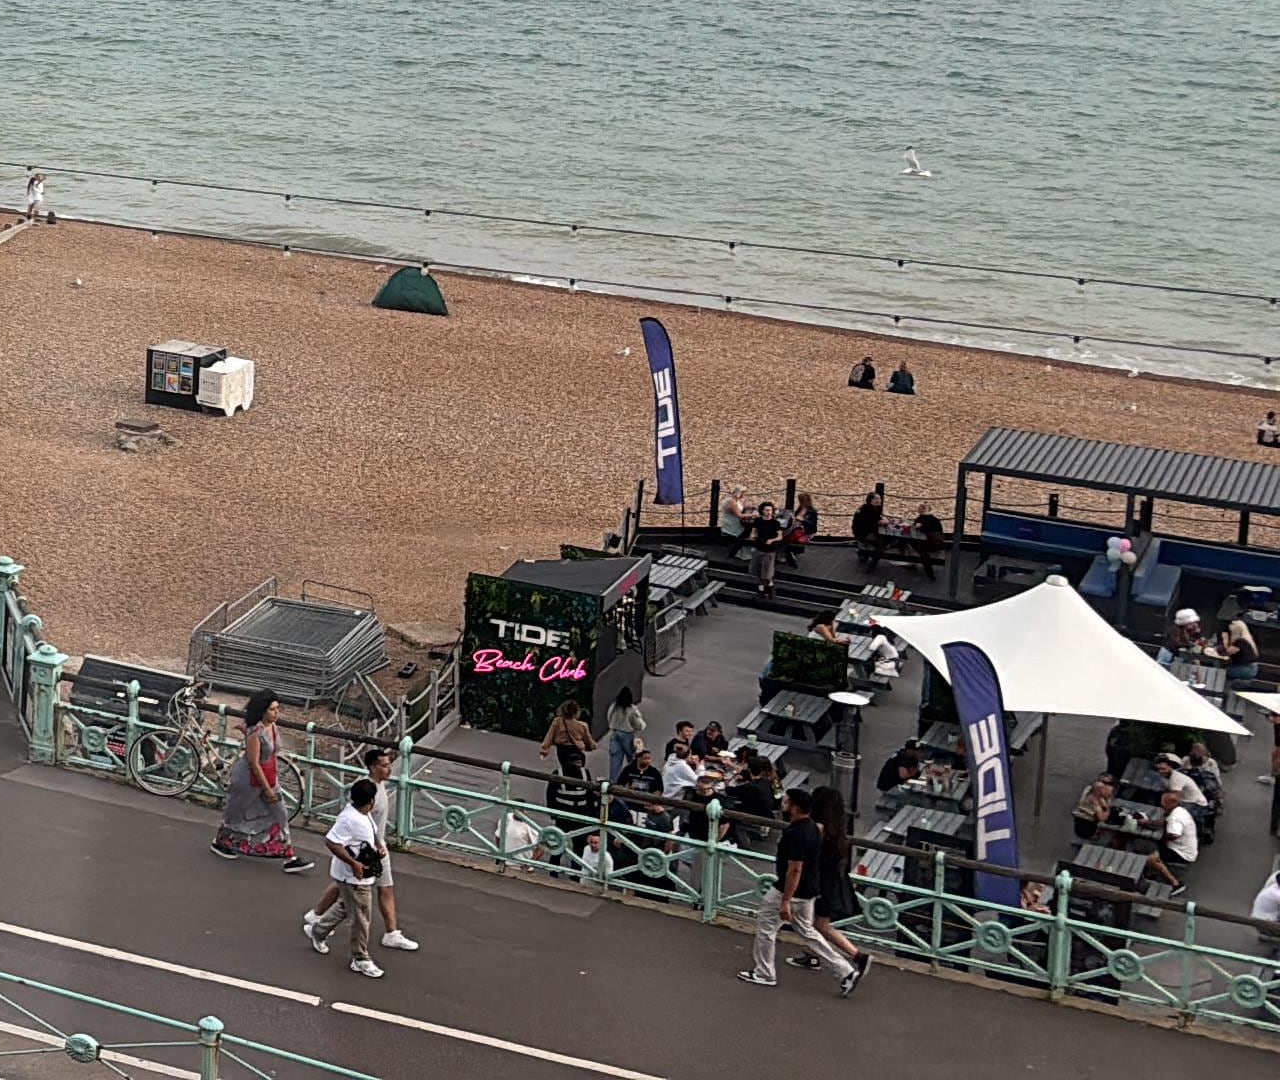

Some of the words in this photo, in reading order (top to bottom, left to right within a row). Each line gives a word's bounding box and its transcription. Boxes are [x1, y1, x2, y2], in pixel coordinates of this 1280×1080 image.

[653, 367, 678, 470] TIDE
[472, 648, 536, 673] Beach
[538, 655, 588, 683] Club
[489, 618, 571, 650] TIDE
[968, 713, 1011, 860] TIDE
